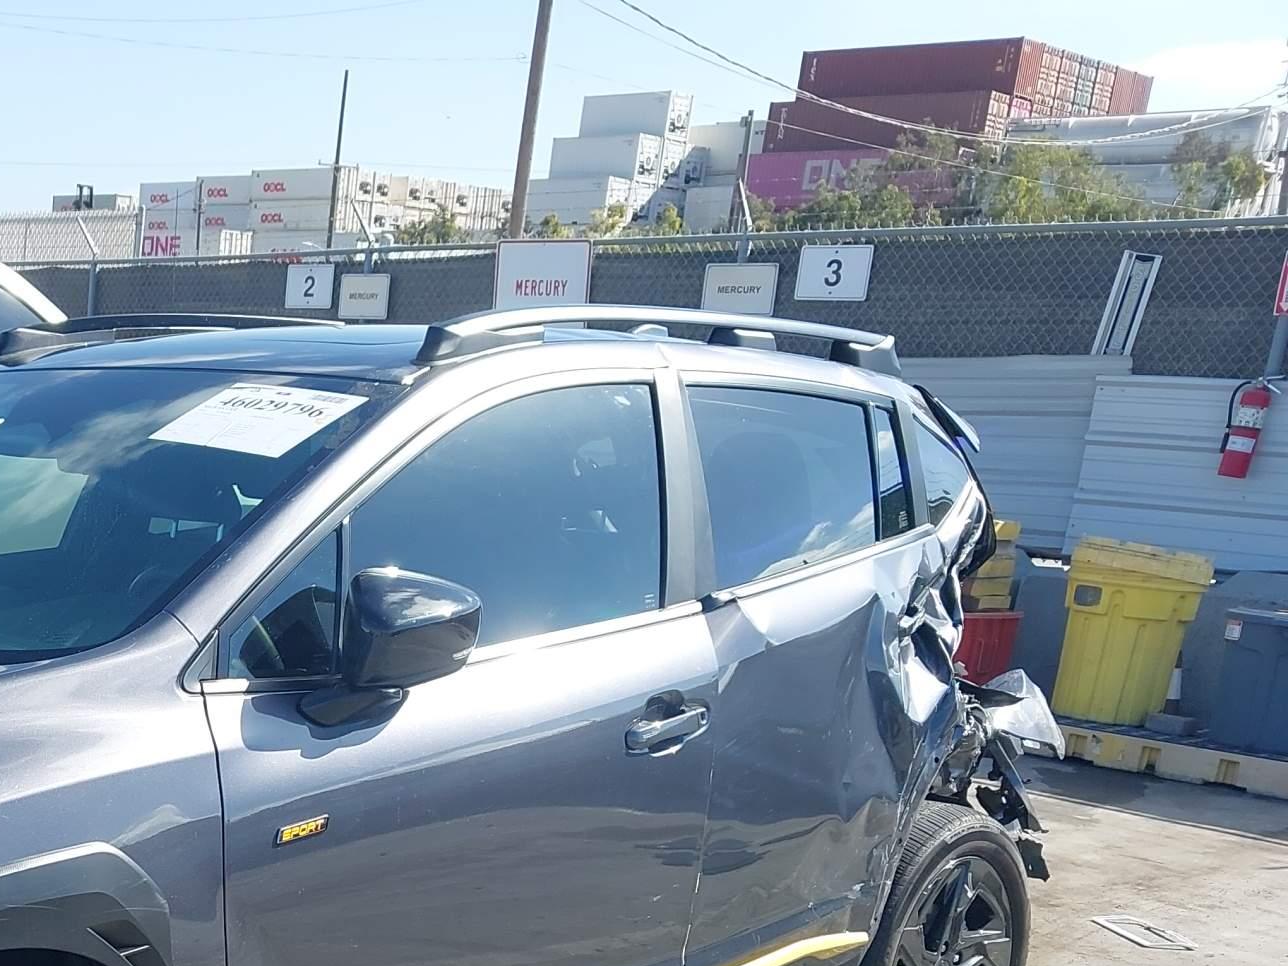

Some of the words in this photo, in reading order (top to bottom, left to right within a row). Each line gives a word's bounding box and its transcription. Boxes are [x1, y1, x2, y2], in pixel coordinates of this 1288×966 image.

[207, 187, 228, 198] OOCL
[263, 181, 286, 193] OOCL
[150, 193, 170, 203] OOCL
[204, 216, 226, 227] OOCL
[260, 212, 283, 224] OOCL
[148, 220, 168, 231] OOCL
[141, 235, 181, 257] ONE
[823, 258, 843, 287] 3
[303, 275, 316, 298] 2
[515, 279, 569, 297] MERCURY
[717, 285, 762, 294] MERCURY
[348, 292, 379, 301] MERCURY
[220, 396, 329, 418] 46029796
[282, 819, 325, 842] SPORT
